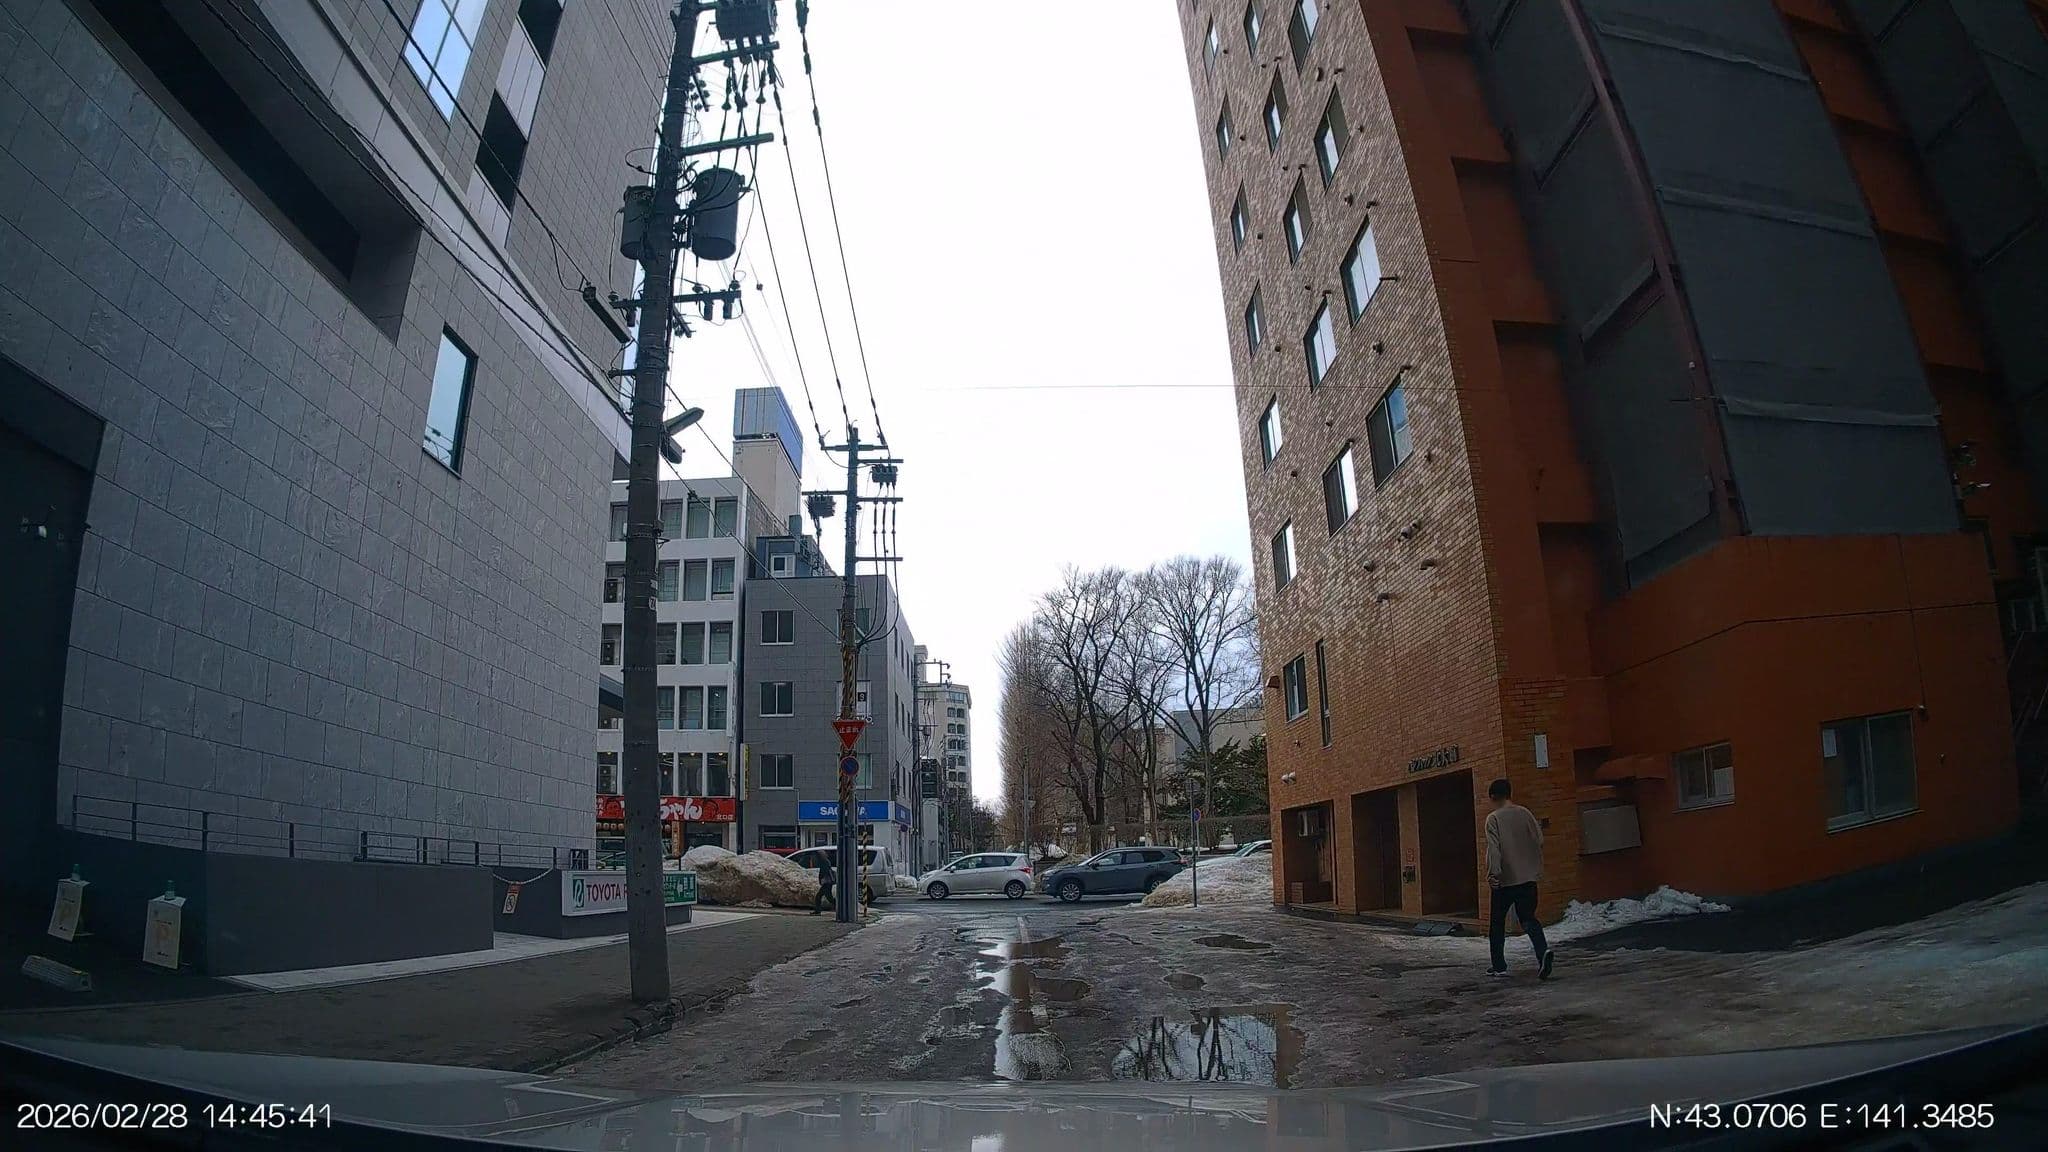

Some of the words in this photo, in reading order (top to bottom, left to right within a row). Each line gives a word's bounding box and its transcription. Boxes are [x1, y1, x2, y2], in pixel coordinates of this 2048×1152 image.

[839, 726, 860, 734] 止まれ
[586, 883, 621, 902] TOYOTA
